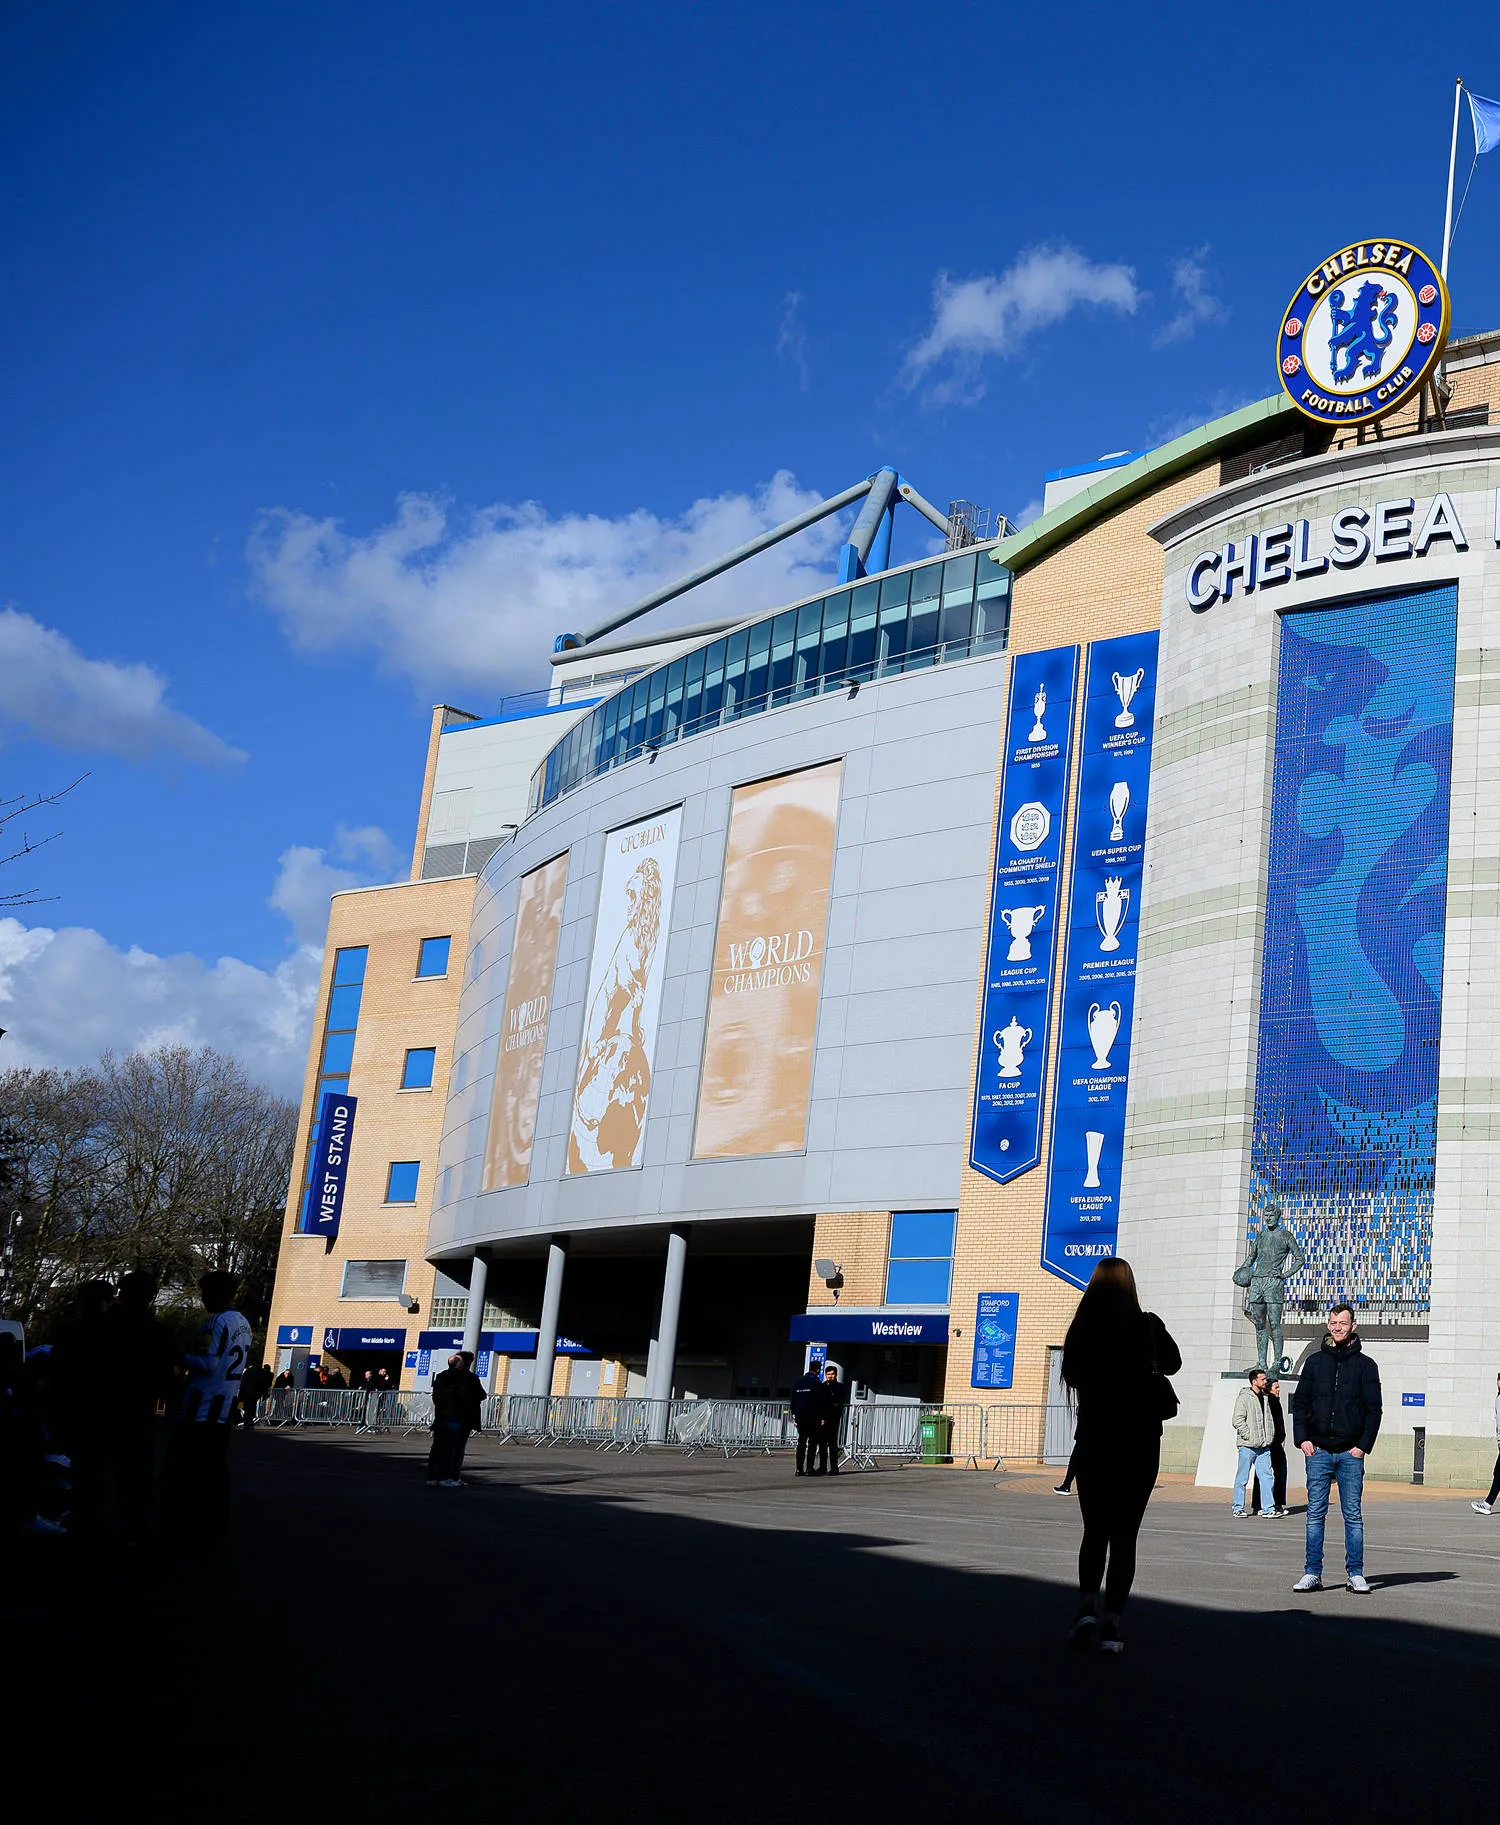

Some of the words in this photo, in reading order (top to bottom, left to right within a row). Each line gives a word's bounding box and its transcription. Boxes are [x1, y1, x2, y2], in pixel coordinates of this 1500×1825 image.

[1306, 243, 1415, 295] CHELSEA
[1301, 388, 1375, 414] FOOTBALL
[1376, 365, 1414, 398] CLUB
[1185, 491, 1470, 614] CHELSEA
[1125, 731, 1139, 739] CUP
[1016, 747, 1032, 755] FIRST
[1032, 743, 1059, 752] DIVISION
[1102, 739, 1132, 749] WINNER'S
[1132, 736, 1146, 744] CUP
[1014, 750, 1059, 761] CHAMPIONSHIP
[619, 832, 640, 854] CFC
[645, 823, 667, 848] LDN
[1107, 846, 1128, 854] SUPER
[1128, 844, 1142, 852] CUP
[999, 864, 1035, 873] COMMUNITY
[1034, 861, 1057, 870] SHIELD
[1017, 856, 1043, 865] CHARITY
[728, 930, 815, 971] WORLD
[1082, 960, 1110, 969] PREMIER
[1110, 958, 1135, 967] LEAGUE
[1000, 968, 1024, 976] LEAGUE
[723, 963, 812, 995] CHAMPIONS
[504, 1024, 547, 1054] CHAMPIONS
[1089, 1075, 1127, 1084] CHAMPIONS
[327, 1105, 349, 1166] STAND
[319, 1172, 339, 1223] WEST
[1064, 1244, 1085, 1256] CFC
[1091, 1244, 1114, 1256] LDN
[871, 1321, 923, 1335] Westview
